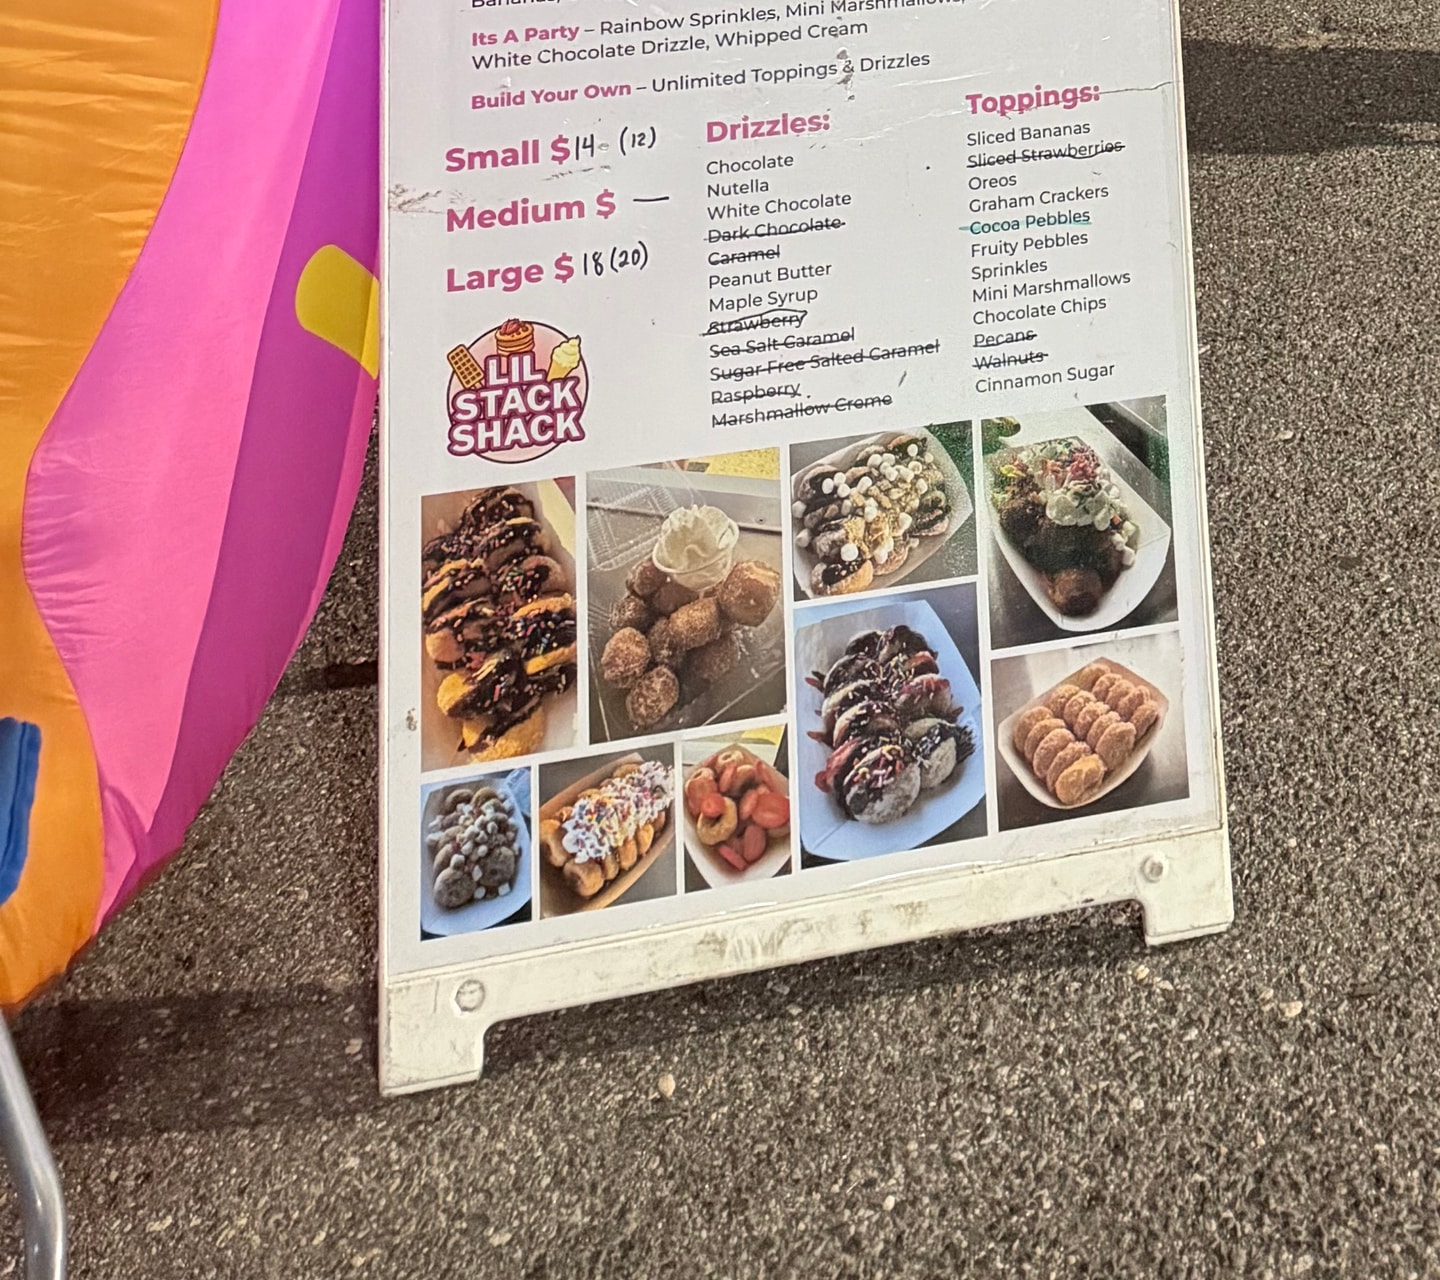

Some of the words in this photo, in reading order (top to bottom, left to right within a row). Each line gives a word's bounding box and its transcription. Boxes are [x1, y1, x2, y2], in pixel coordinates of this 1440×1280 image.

[472, 31, 497, 46] Its
[503, 29, 519, 43] A
[525, 24, 579, 42] Party
[600, 16, 684, 35] Rainbow
[690, 7, 780, 29] Sprinkles,
[786, 1, 824, 18] Mini
[472, 50, 532, 70] White
[538, 43, 635, 64] Chocolate
[642, 36, 709, 55] Drizzle,
[715, 28, 801, 47] Whipped
[808, 21, 867, 38] Cream
[472, 91, 525, 109] Build
[531, 88, 578, 104] Your
[584, 83, 631, 99] Own
[652, 69, 745, 92] Unlimited
[751, 64, 838, 82] Toppings
[843, 60, 854, 73] &
[860, 52, 930, 72] Drizzles
[965, 85, 1100, 116] Toppings:
[706, 113, 831, 143] Drizzles:
[967, 128, 1015, 146] Sliced
[1021, 122, 1091, 140] Bananas
[446, 139, 539, 172] Small
[706, 154, 794, 176] Chocolate
[967, 150, 1016, 168] Sliced
[1021, 139, 1123, 162] Strawberries
[707, 179, 769, 198] Nutella
[968, 174, 1017, 191] Oreos
[707, 202, 760, 220] White
[765, 192, 852, 214] Chocolate
[969, 194, 1035, 213] Graham
[1040, 185, 1109, 205] Crackers
[448, 198, 584, 232] Medium
[970, 218, 1020, 235] Cocoa
[1026, 210, 1091, 229] Pebbles
[708, 225, 749, 243] Dark
[755, 216, 842, 238] Chocolate
[708, 245, 780, 266] Caramel
[971, 239, 1018, 257] Fruity
[1023, 232, 1088, 251] Pebbles
[447, 262, 543, 292] Large
[709, 269, 772, 289] Peanut
[777, 262, 832, 281] Butter
[971, 260, 1048, 282] Sprinkles
[709, 292, 762, 313] Maple
[767, 287, 818, 307] Syrup
[972, 284, 1008, 303] Mini
[1013, 271, 1131, 298] Marshmallows
[707, 312, 803, 335] Strawberry
[973, 301, 1056, 325] Chocolate
[1061, 297, 1107, 315] Chips
[710, 343, 741, 358] Sea
[746, 337, 778, 353] Salt
[784, 327, 855, 349] Caramel
[973, 329, 1035, 347] Pecans
[486, 353, 544, 387] LIL
[710, 366, 762, 382] Sugar
[768, 357, 805, 375] Free
[810, 351, 863, 369] Salted
[869, 339, 940, 361] Caramel
[974, 351, 1044, 370] Walnuts
[976, 368, 1062, 393] Cinnamon
[1067, 363, 1115, 381] Sugar
[453, 378, 579, 422] STACK
[711, 383, 801, 404] Raspberry
[711, 402, 829, 428] Marshmallow
[450, 411, 582, 454] SHACK
